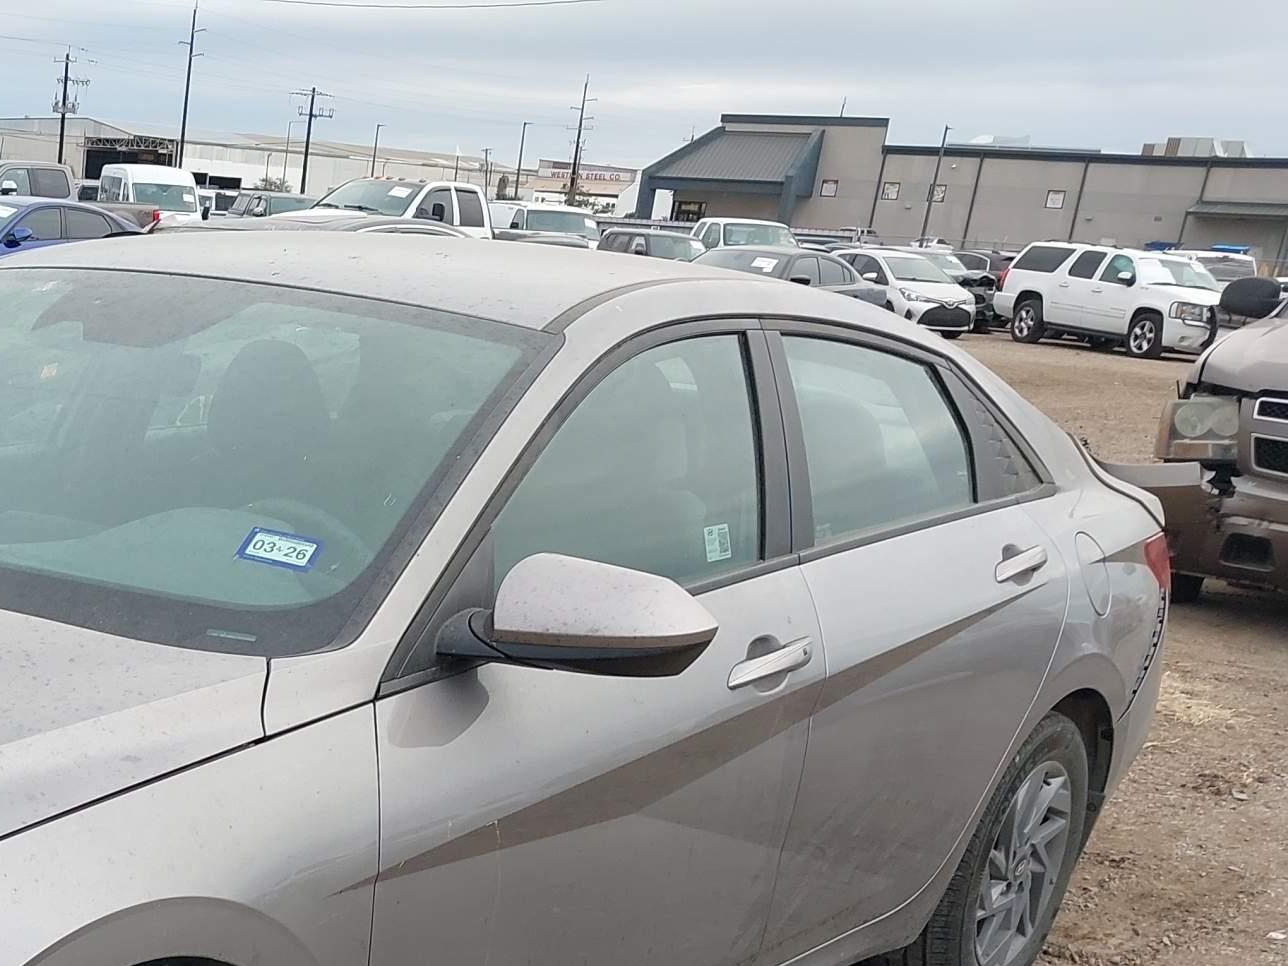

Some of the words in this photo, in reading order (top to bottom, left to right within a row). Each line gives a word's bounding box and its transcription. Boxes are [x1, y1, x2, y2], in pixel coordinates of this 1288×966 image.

[585, 172, 608, 181] STEEL
[252, 539, 276, 553] 03
[282, 546, 309, 560] 26
